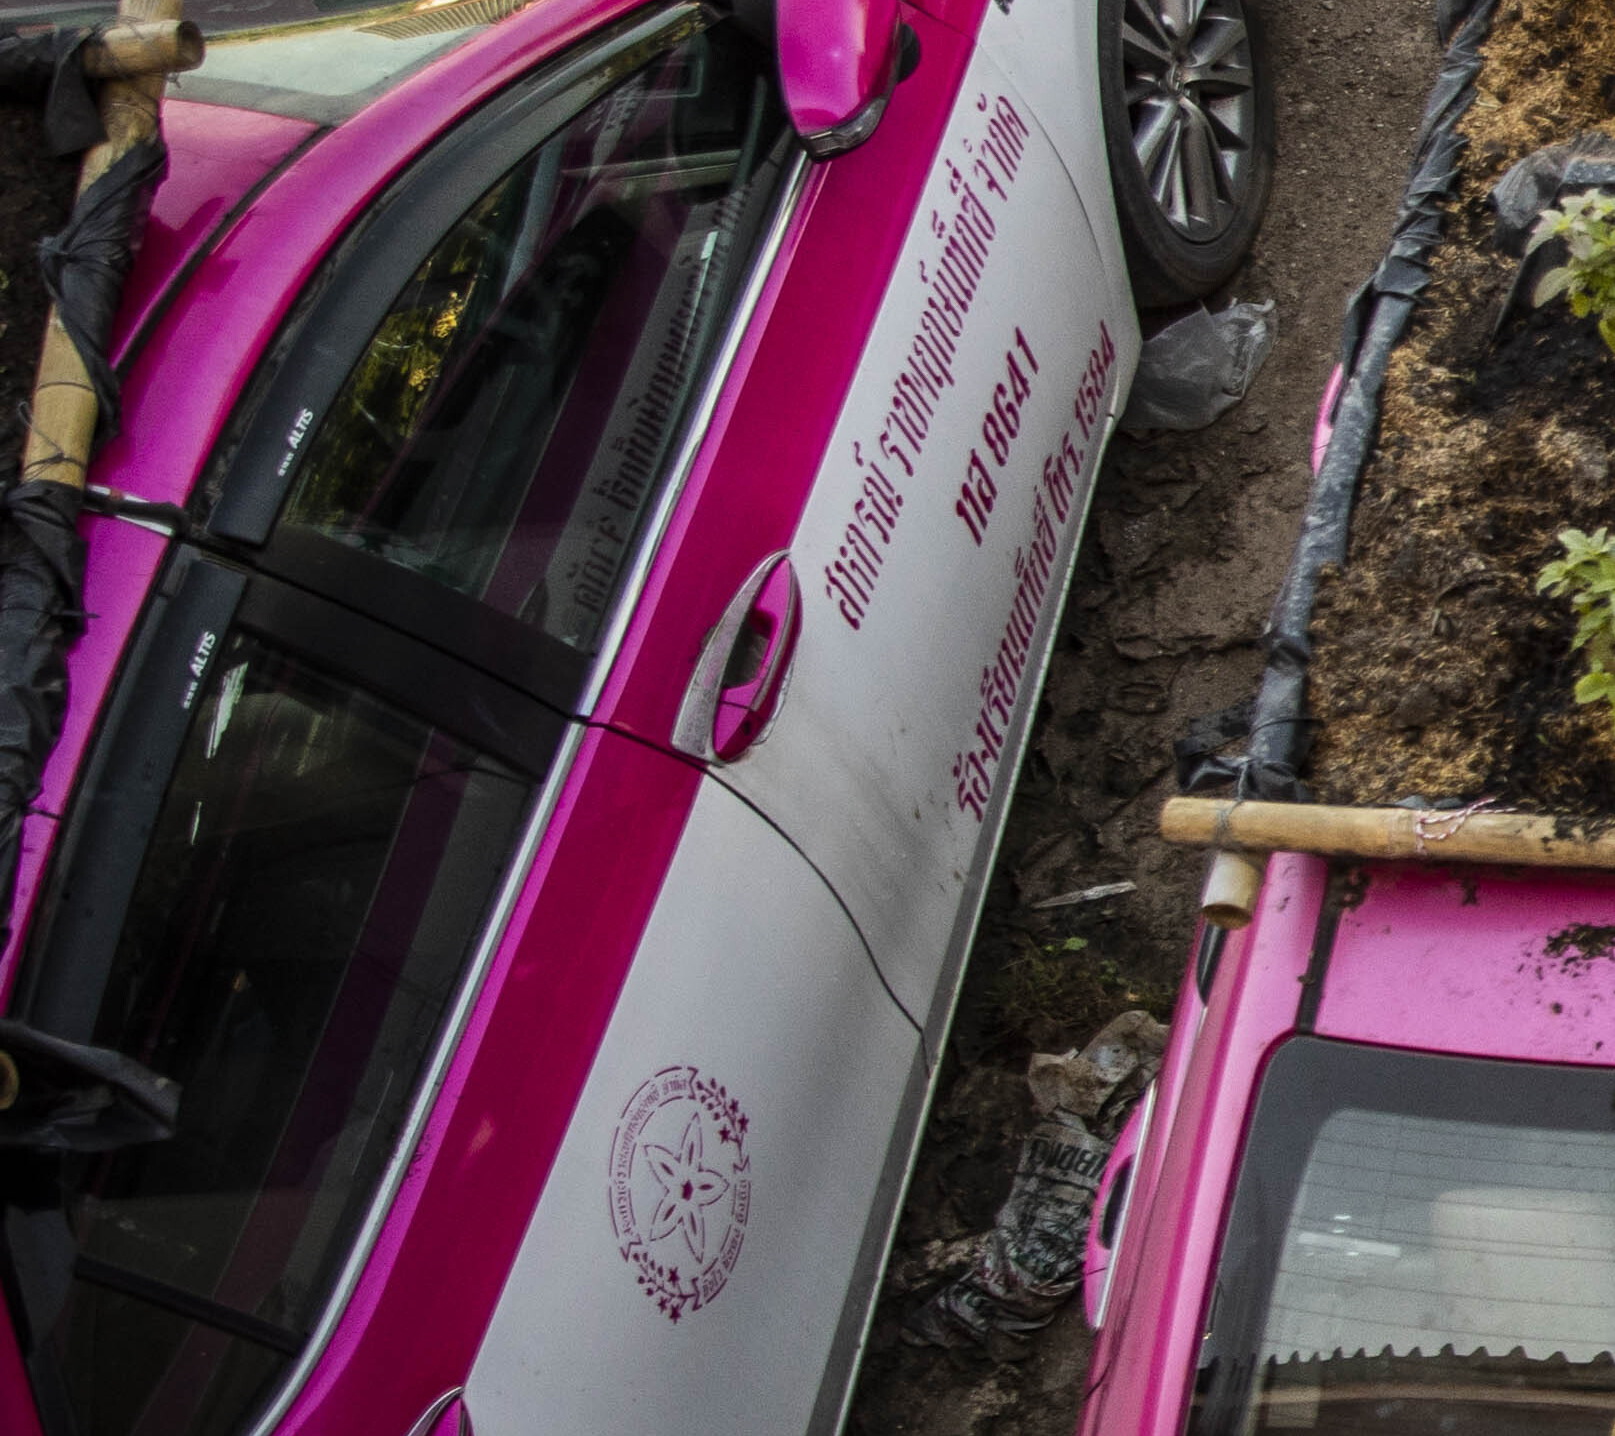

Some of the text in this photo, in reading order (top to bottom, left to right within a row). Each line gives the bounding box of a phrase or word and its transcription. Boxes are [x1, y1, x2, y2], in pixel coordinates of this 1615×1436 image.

[963, 92, 1033, 202] จำกัด
[288, 408, 314, 450] ALTIS
[956, 326, 1042, 548] ทส 8641
[1073, 318, 1119, 446] 1584
[191, 631, 216, 677] ALTIS
